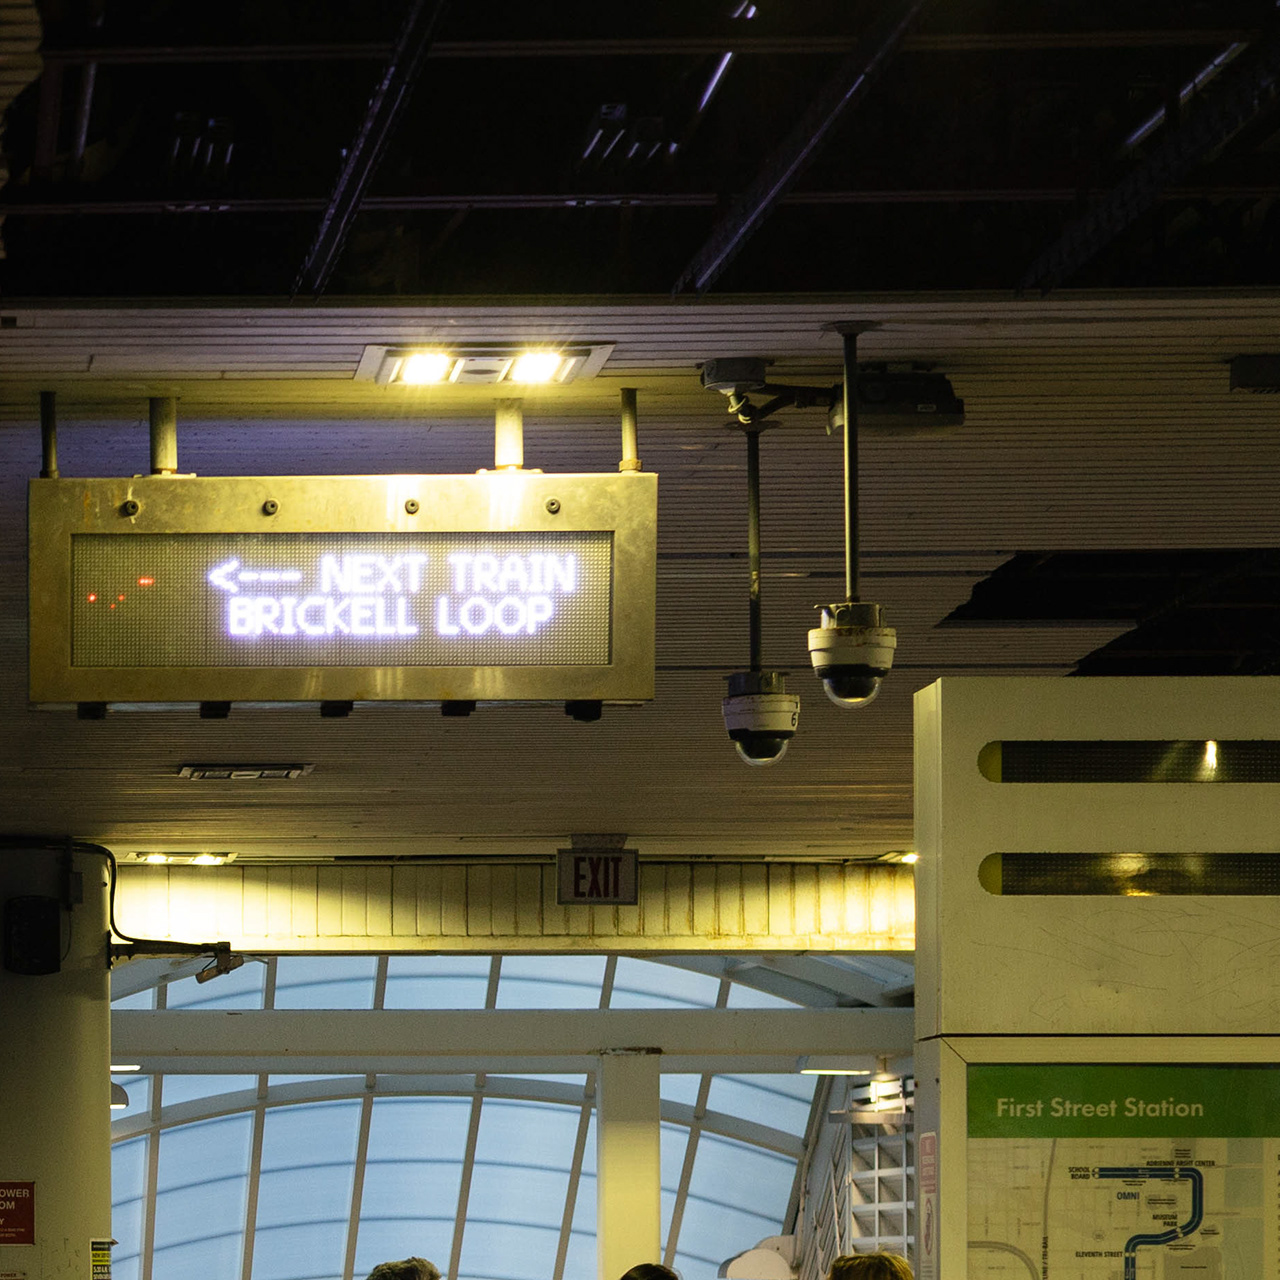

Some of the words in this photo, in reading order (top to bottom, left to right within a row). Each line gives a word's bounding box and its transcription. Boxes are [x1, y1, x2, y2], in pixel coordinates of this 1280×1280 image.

[321, 553, 426, 592] NEXT
[448, 553, 577, 592] TRAIN
[229, 597, 418, 634] BRICKELL
[438, 597, 553, 634] LOOP
[574, 857, 622, 897] EXIT
[997, 1097, 1043, 1117] First
[1050, 1097, 1117, 1117] Street
[1124, 1097, 1204, 1117] Station
[1117, 1192, 1140, 1200] OMNI
